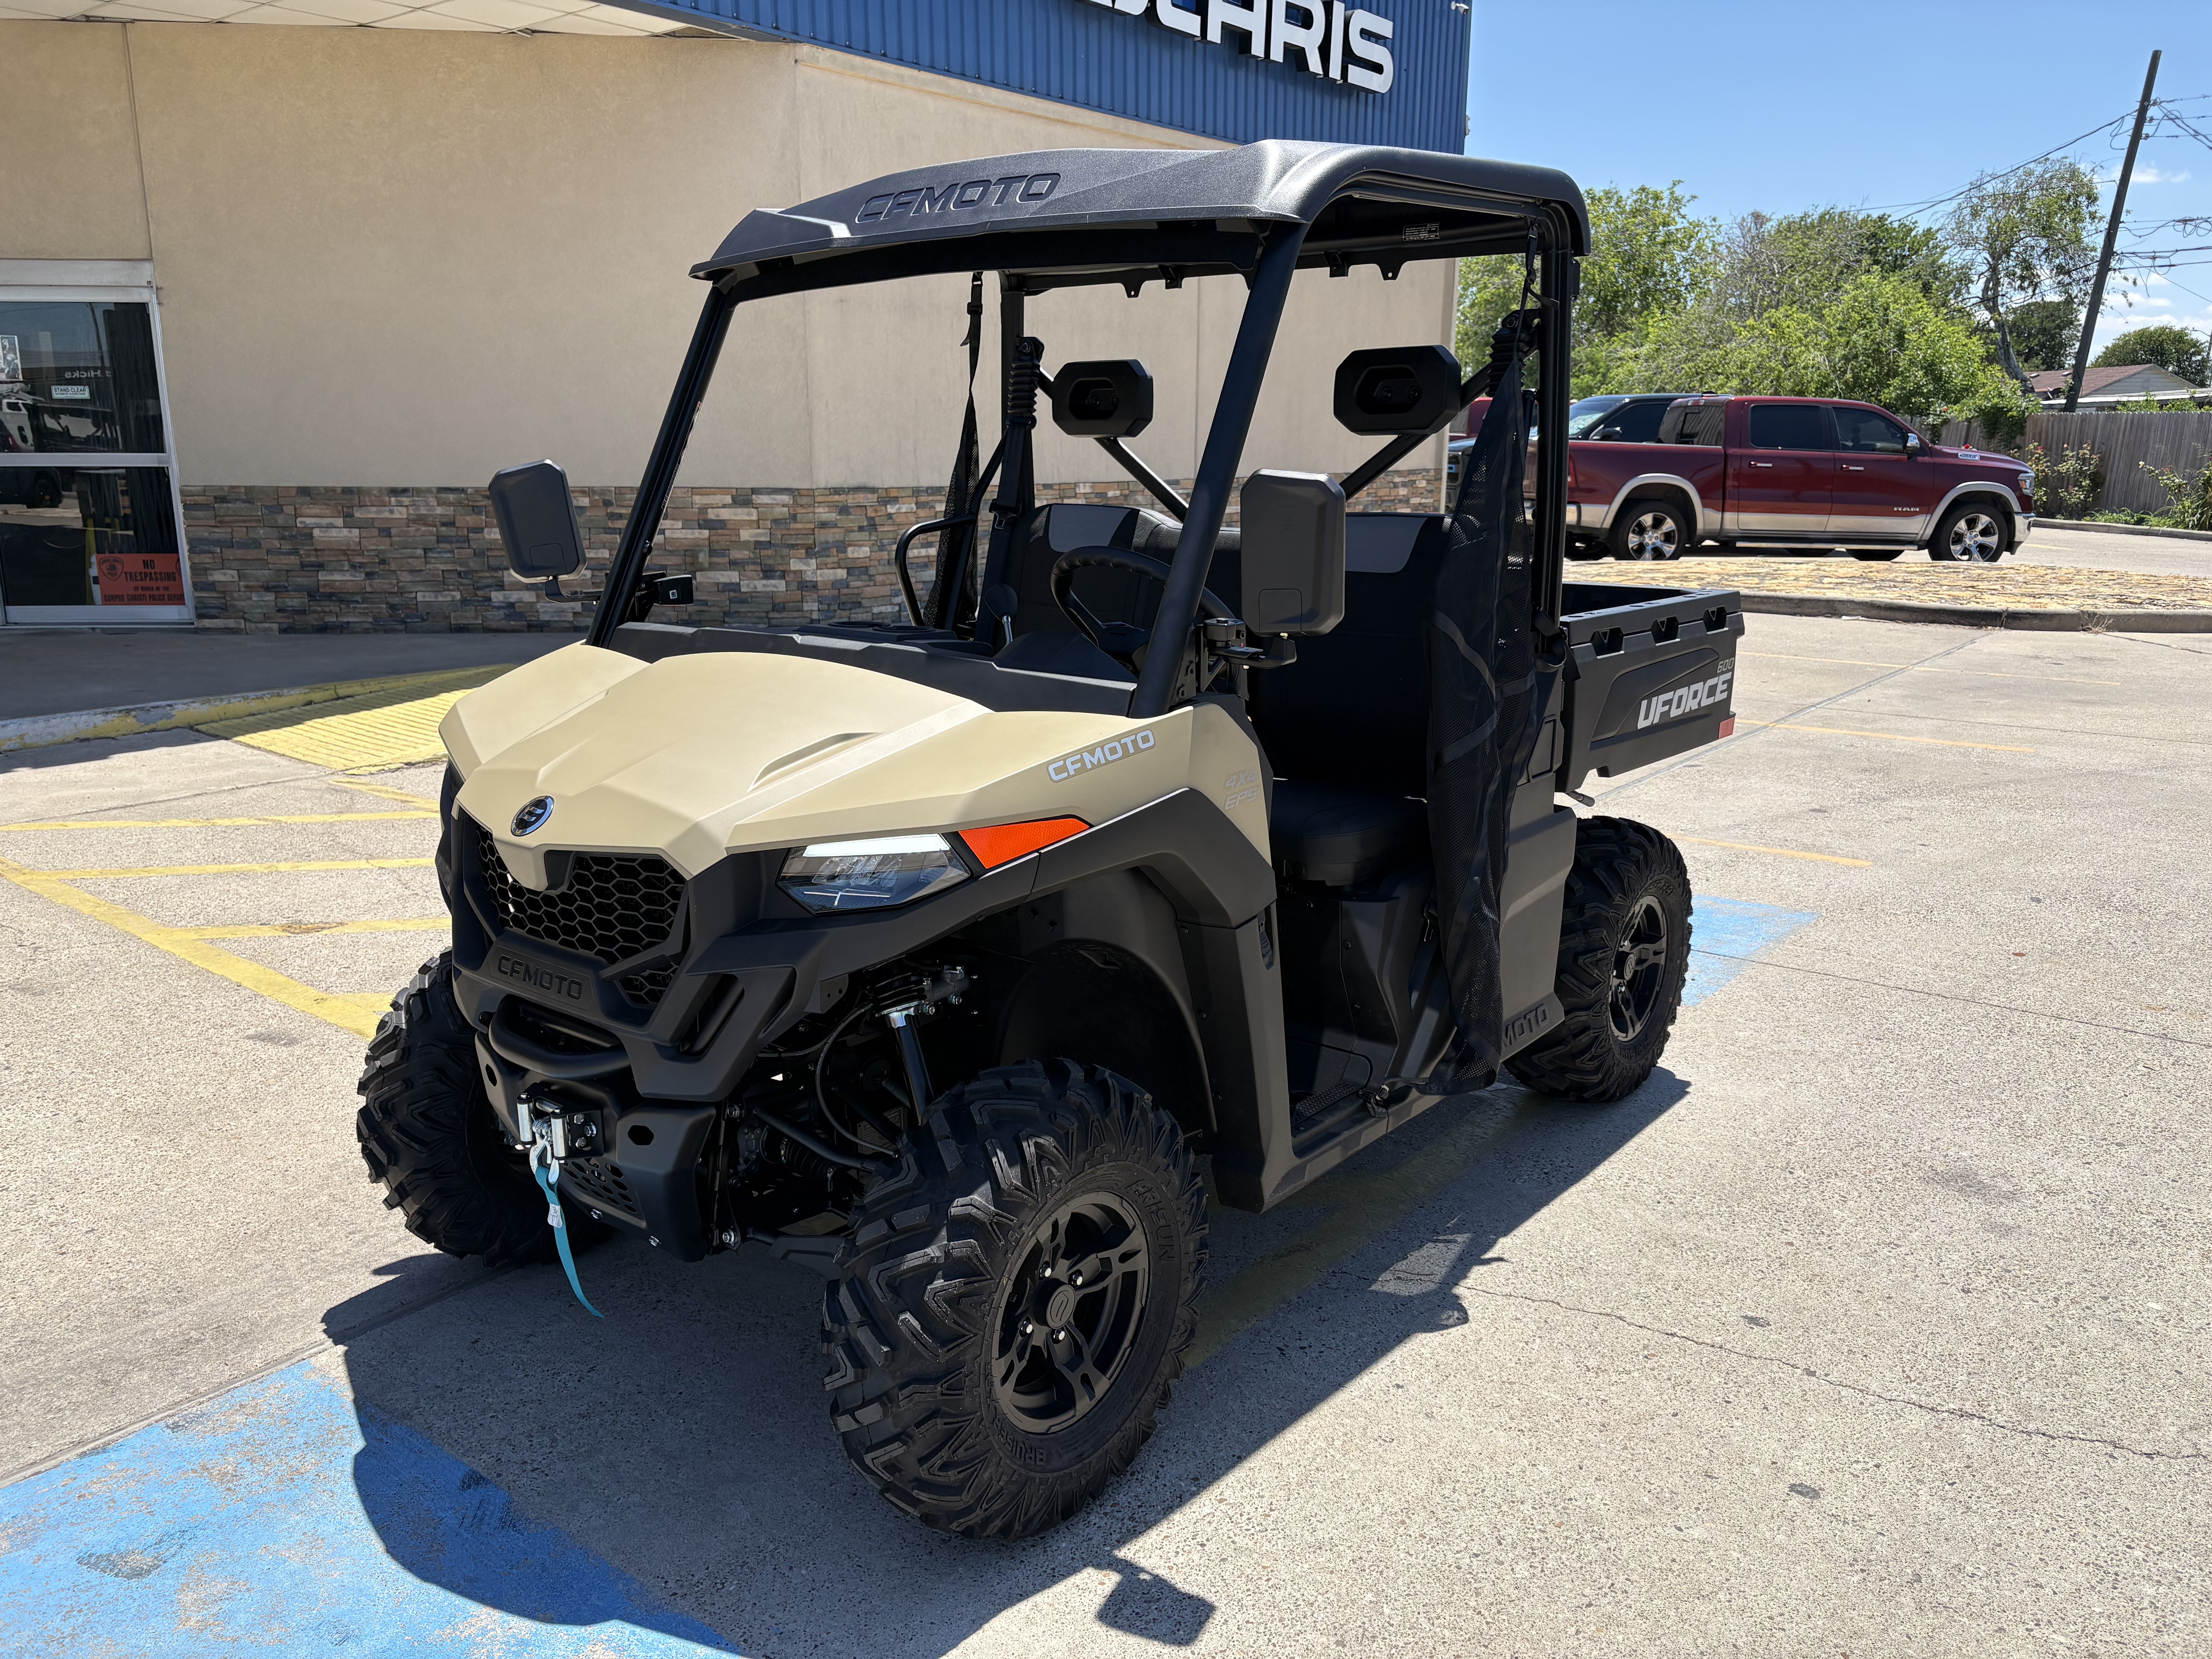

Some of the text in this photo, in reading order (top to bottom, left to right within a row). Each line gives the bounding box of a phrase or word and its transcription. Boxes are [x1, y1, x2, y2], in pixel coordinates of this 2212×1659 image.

[855, 172, 1061, 223] CFMOTO
[124, 572, 177, 582] TRESPASSING
[143, 560, 155, 569] NO
[1717, 658, 1735, 673] 600
[1637, 672, 1731, 730] UFORCE
[1048, 730, 1154, 781] CFMOTO
[1224, 787, 1259, 810] EPS
[498, 954, 582, 1000] CFMOTO
